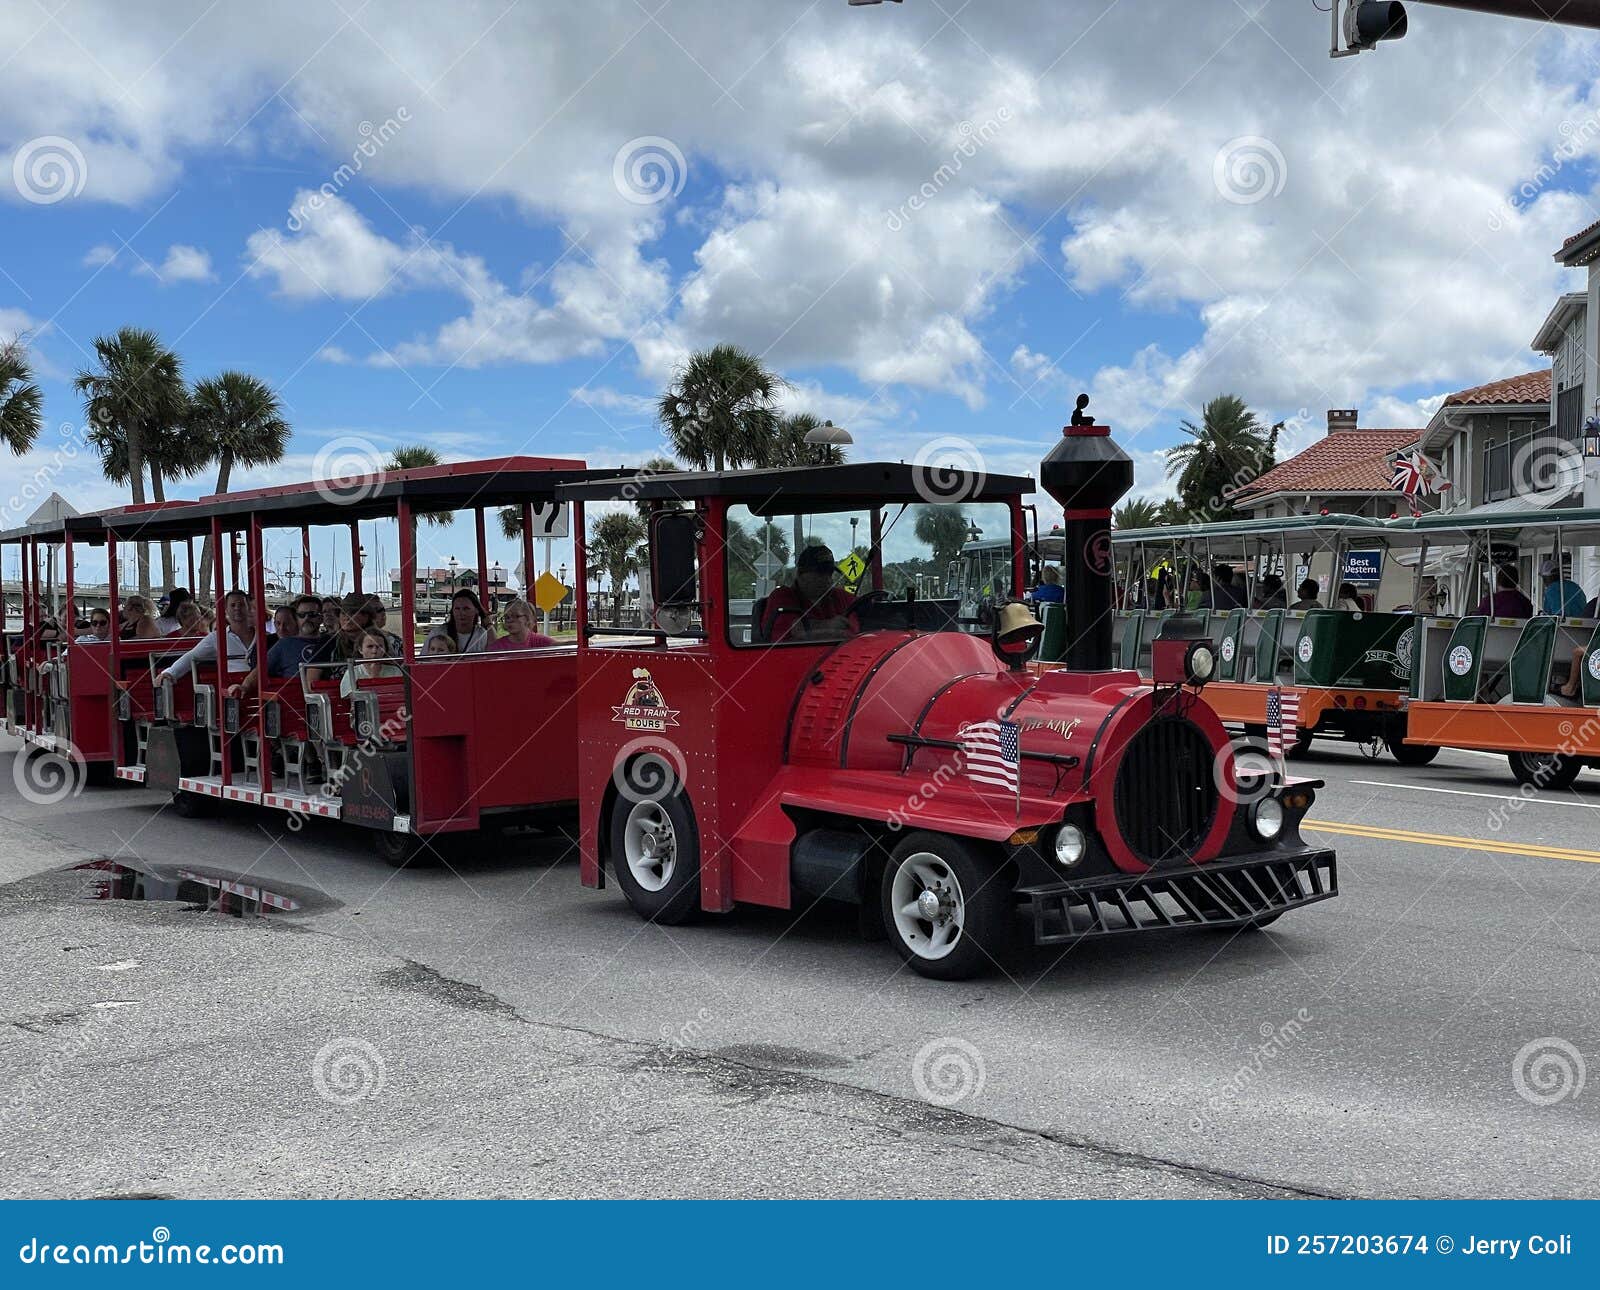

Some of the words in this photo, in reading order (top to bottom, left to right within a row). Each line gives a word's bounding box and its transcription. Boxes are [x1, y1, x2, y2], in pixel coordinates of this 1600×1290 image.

[1350, 558, 1369, 566] Best
[1341, 565, 1377, 574] Western
[1370, 652, 1388, 660] SEE
[1393, 666, 1409, 678] THE
[624, 707, 640, 716] RED
[643, 708, 667, 718] TRAIN
[630, 719, 660, 728] TOURS
[1046, 719, 1077, 740] KING
